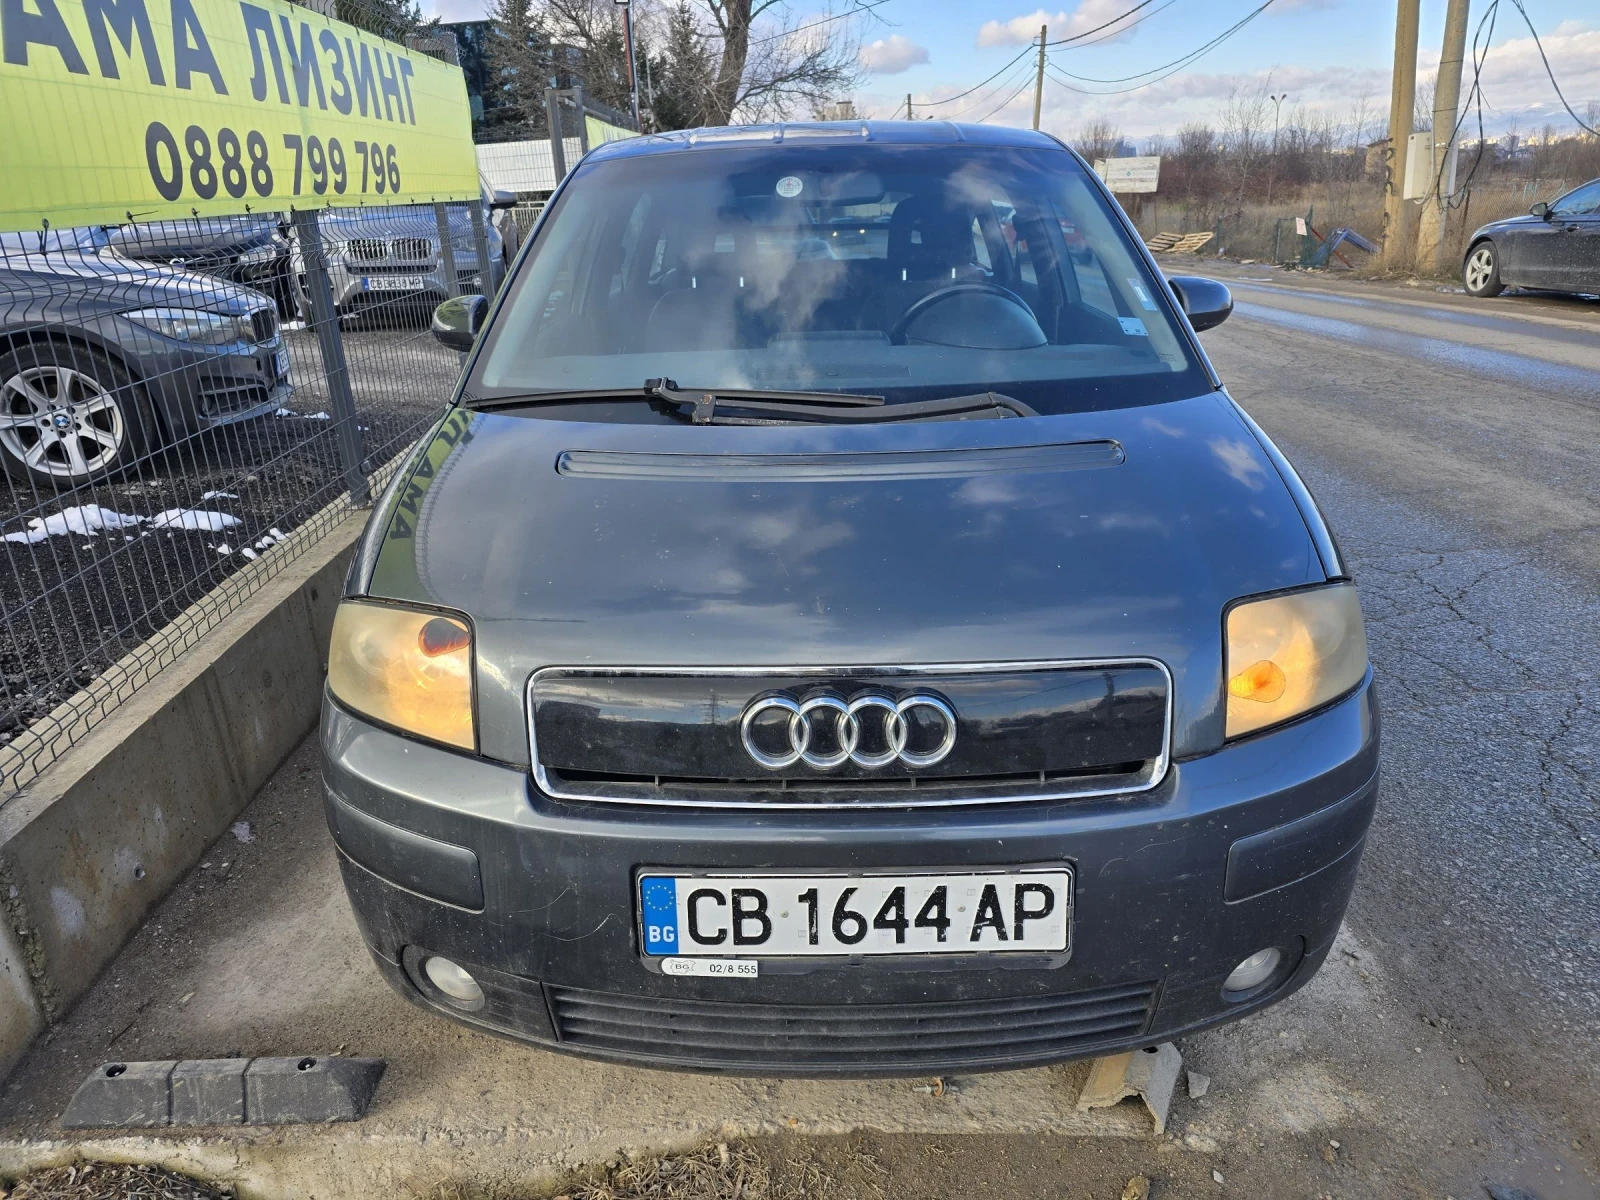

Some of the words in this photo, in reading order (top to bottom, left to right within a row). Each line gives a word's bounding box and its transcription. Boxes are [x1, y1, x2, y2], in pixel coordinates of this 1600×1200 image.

[0, 0, 229, 96] АМА
[239, 1, 417, 126] ЛИЗИНГ
[145, 121, 274, 201] 0888
[283, 133, 348, 196] 799
[355, 141, 401, 195] 796
[648, 925, 675, 943] BG
[686, 887, 772, 946] CB
[797, 885, 951, 946] 1644
[969, 883, 1056, 942] AP
[709, 964, 734, 974] 02/8
[737, 965, 757, 974] 555
